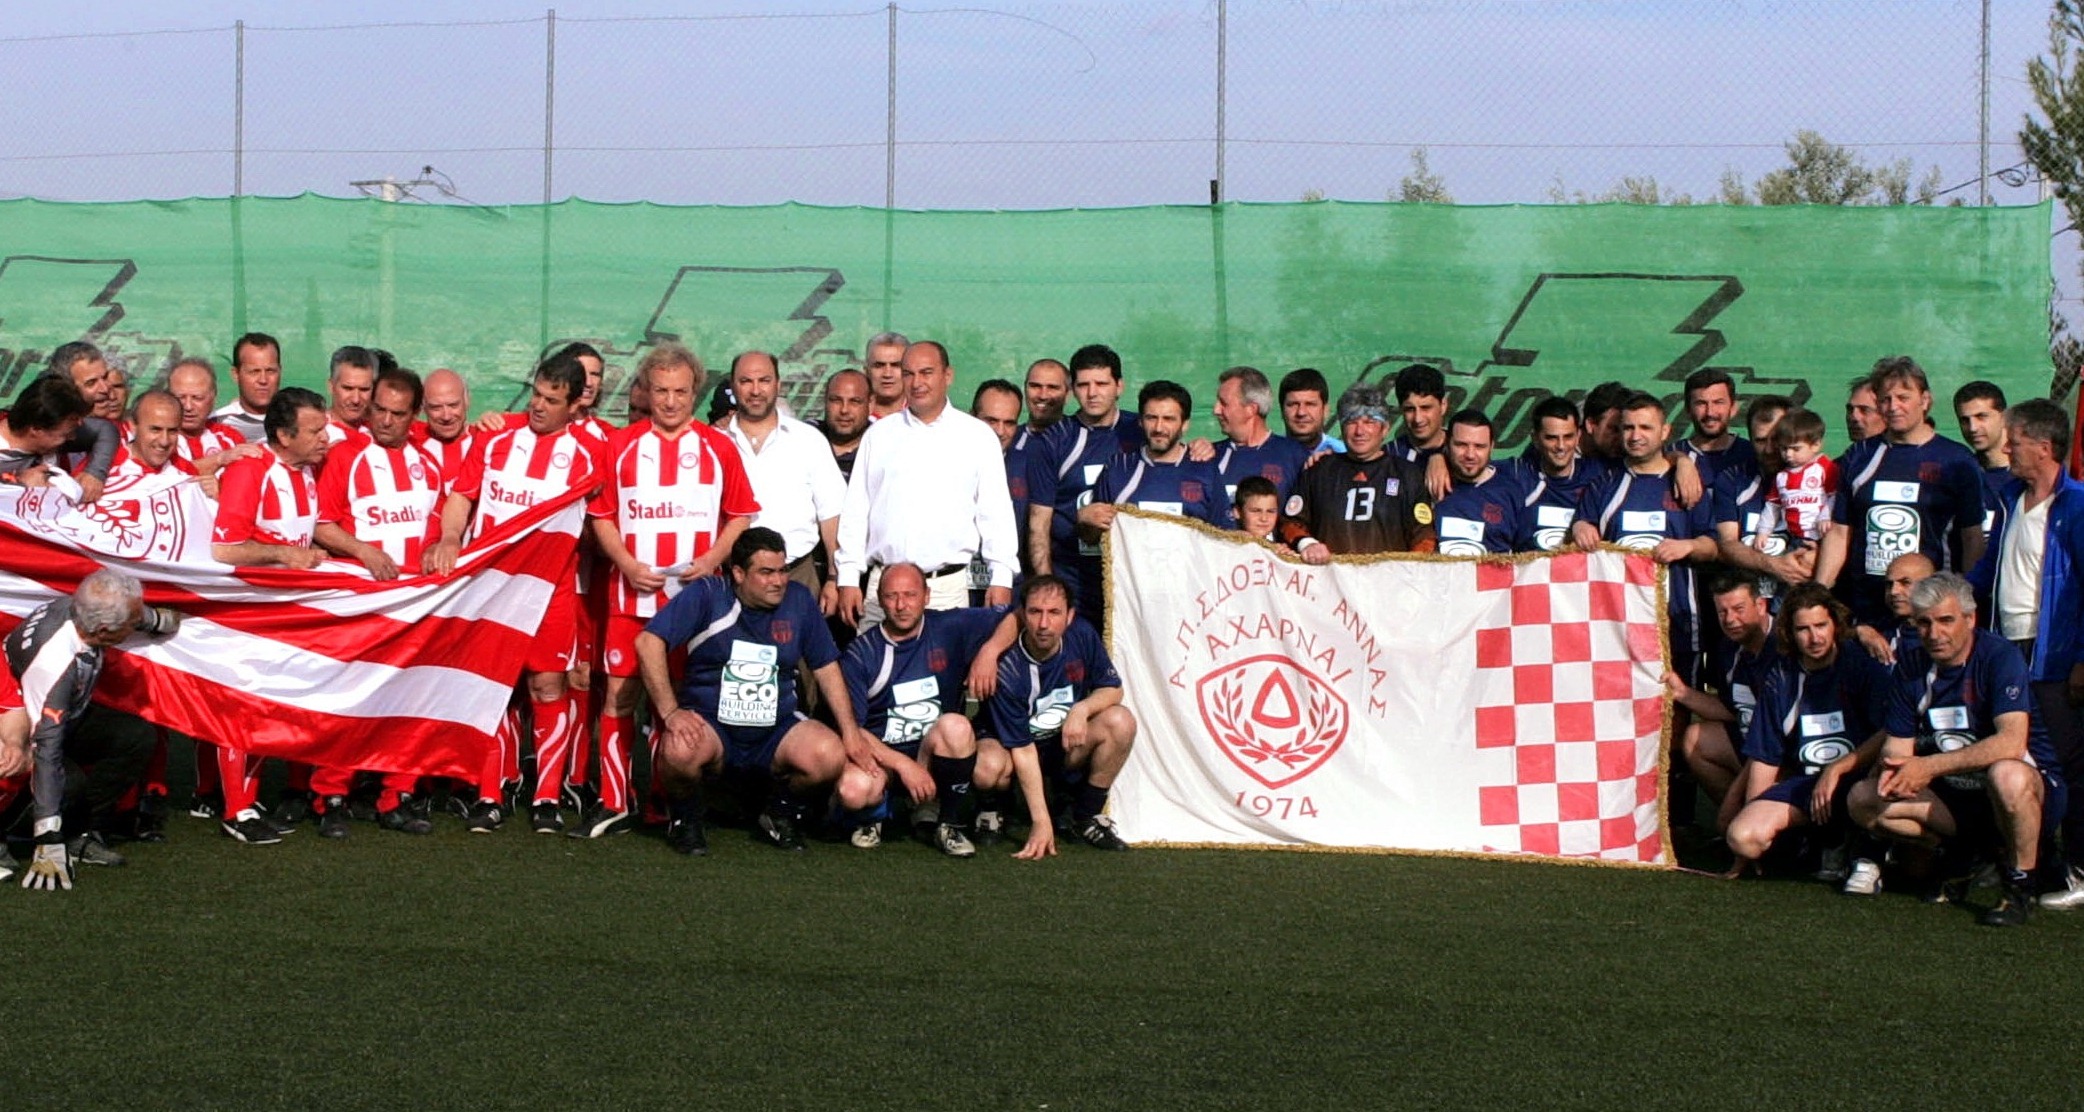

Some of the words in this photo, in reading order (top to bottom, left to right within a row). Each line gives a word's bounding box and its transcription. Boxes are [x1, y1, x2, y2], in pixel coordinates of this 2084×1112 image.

[1344, 487, 1376, 521] 13
[1866, 531, 1918, 551] ECO
[723, 682, 777, 702] ECO
[1235, 791, 1319, 820] 1974
